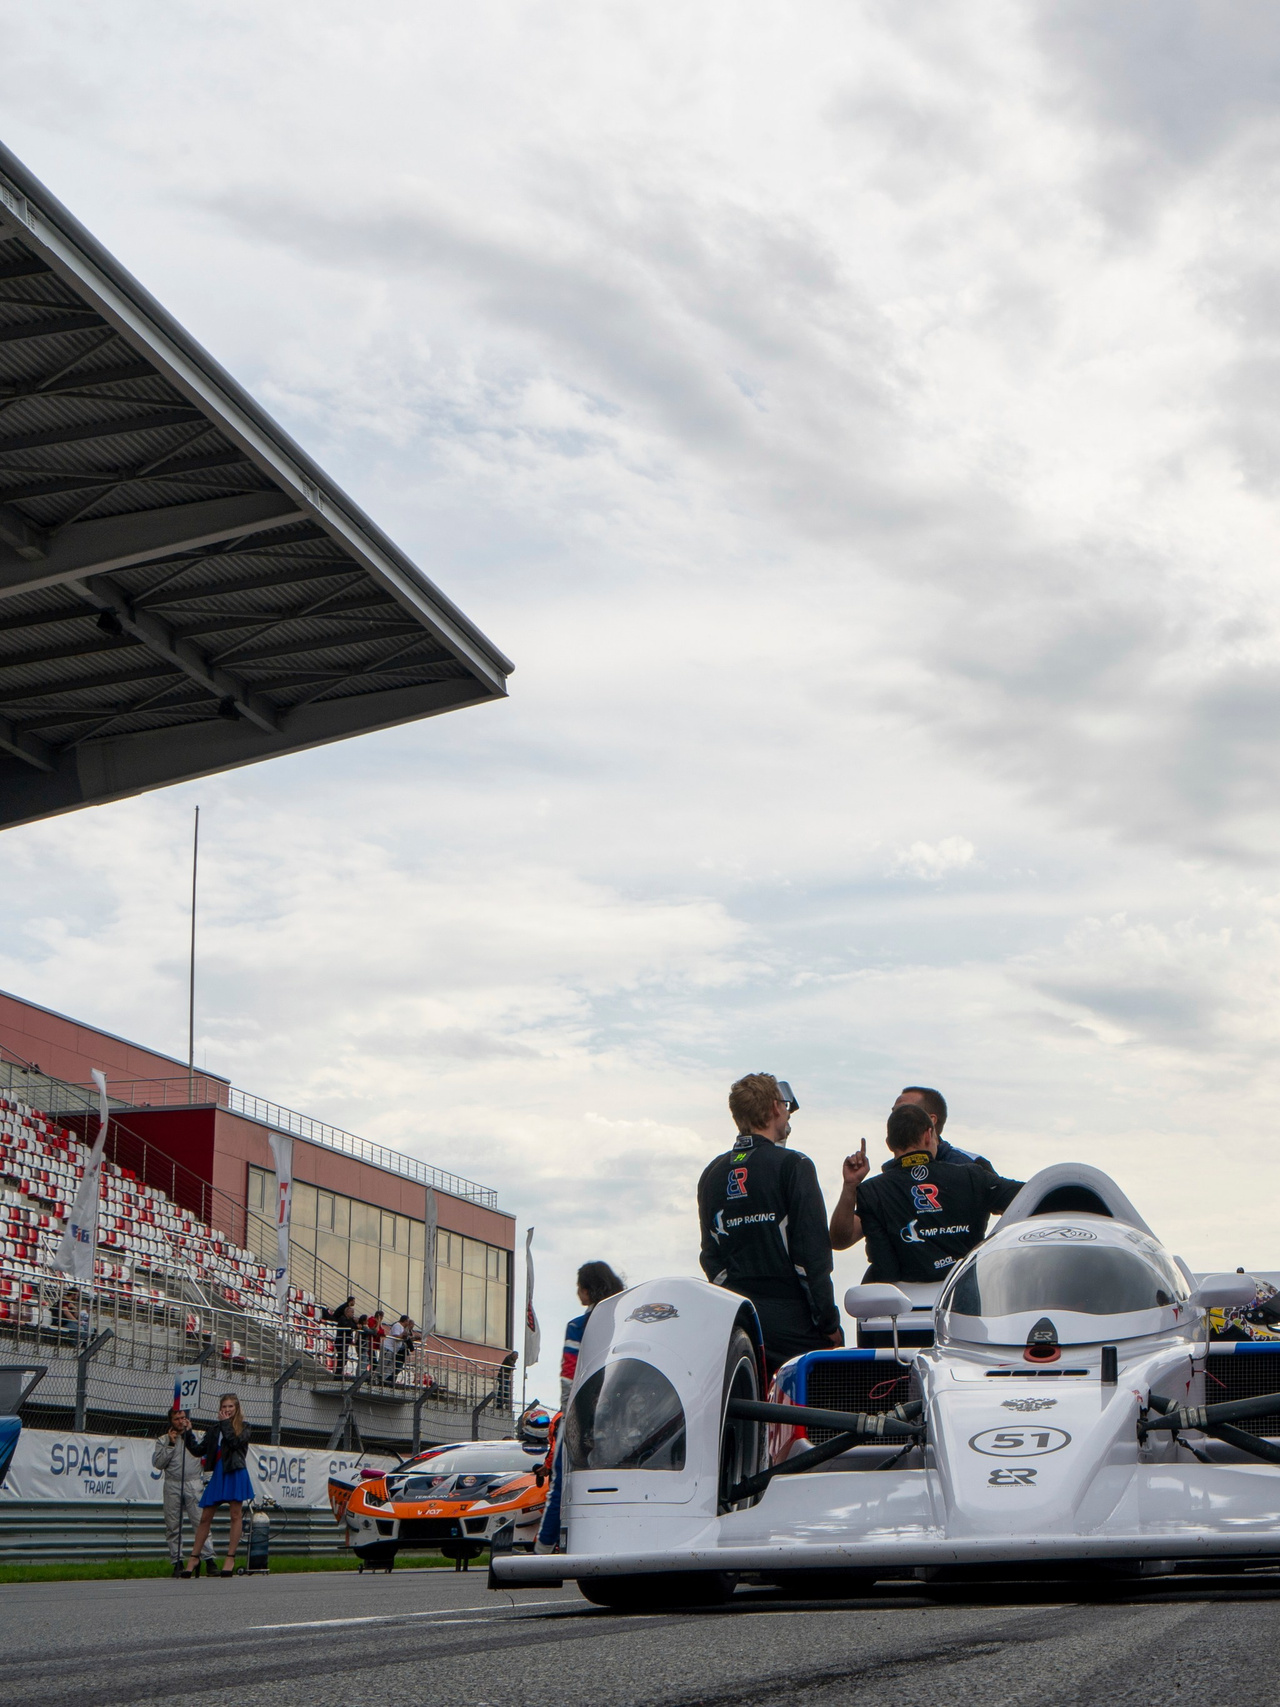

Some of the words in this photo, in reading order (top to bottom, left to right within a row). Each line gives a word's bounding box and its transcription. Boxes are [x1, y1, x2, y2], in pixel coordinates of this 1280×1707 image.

[726, 1217, 743, 1228] SMP
[744, 1213, 776, 1224] RACING
[919, 1227, 938, 1237] SMP
[181, 1379, 198, 1397] 37
[990, 1432, 1050, 1449] 51
[50, 1443, 118, 1478] SPACE
[257, 1455, 306, 1484] SPACE
[84, 1479, 116, 1495] TRAVEL
[282, 1485, 305, 1499] TRAVEL
